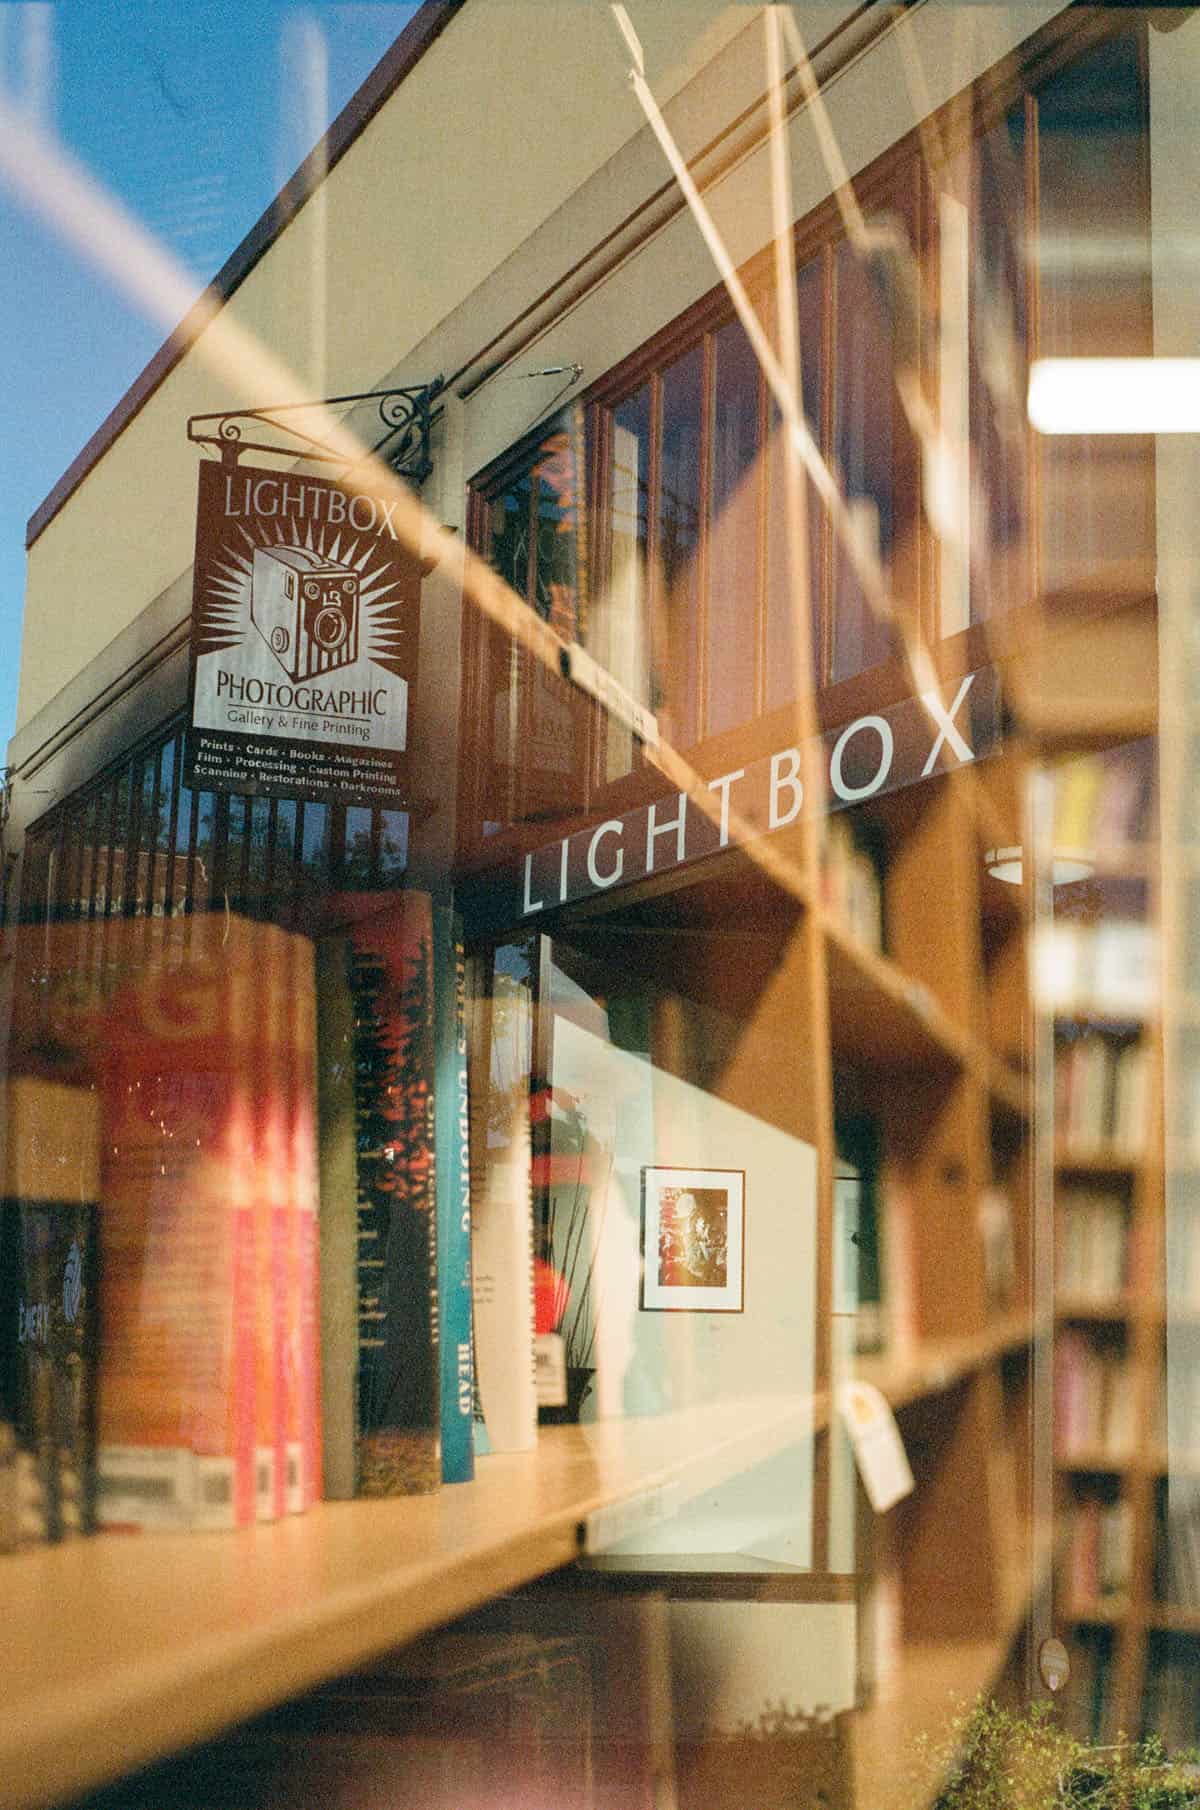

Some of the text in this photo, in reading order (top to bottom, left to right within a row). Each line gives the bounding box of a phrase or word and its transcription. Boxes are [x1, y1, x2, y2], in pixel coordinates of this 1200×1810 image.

[224, 475, 399, 541] LIGHTBOX
[216, 669, 388, 716] PHOTOGRAPHIC
[227, 709, 371, 742] Gallery & Fine Printing
[197, 752, 397, 785] Film Processing Custom Printing
[200, 738, 393, 769] Prints Cards Books Magazines
[193, 764, 401, 796] Scanning Restorations Darkrooms
[523, 674, 976, 918] LIGHTBOX
